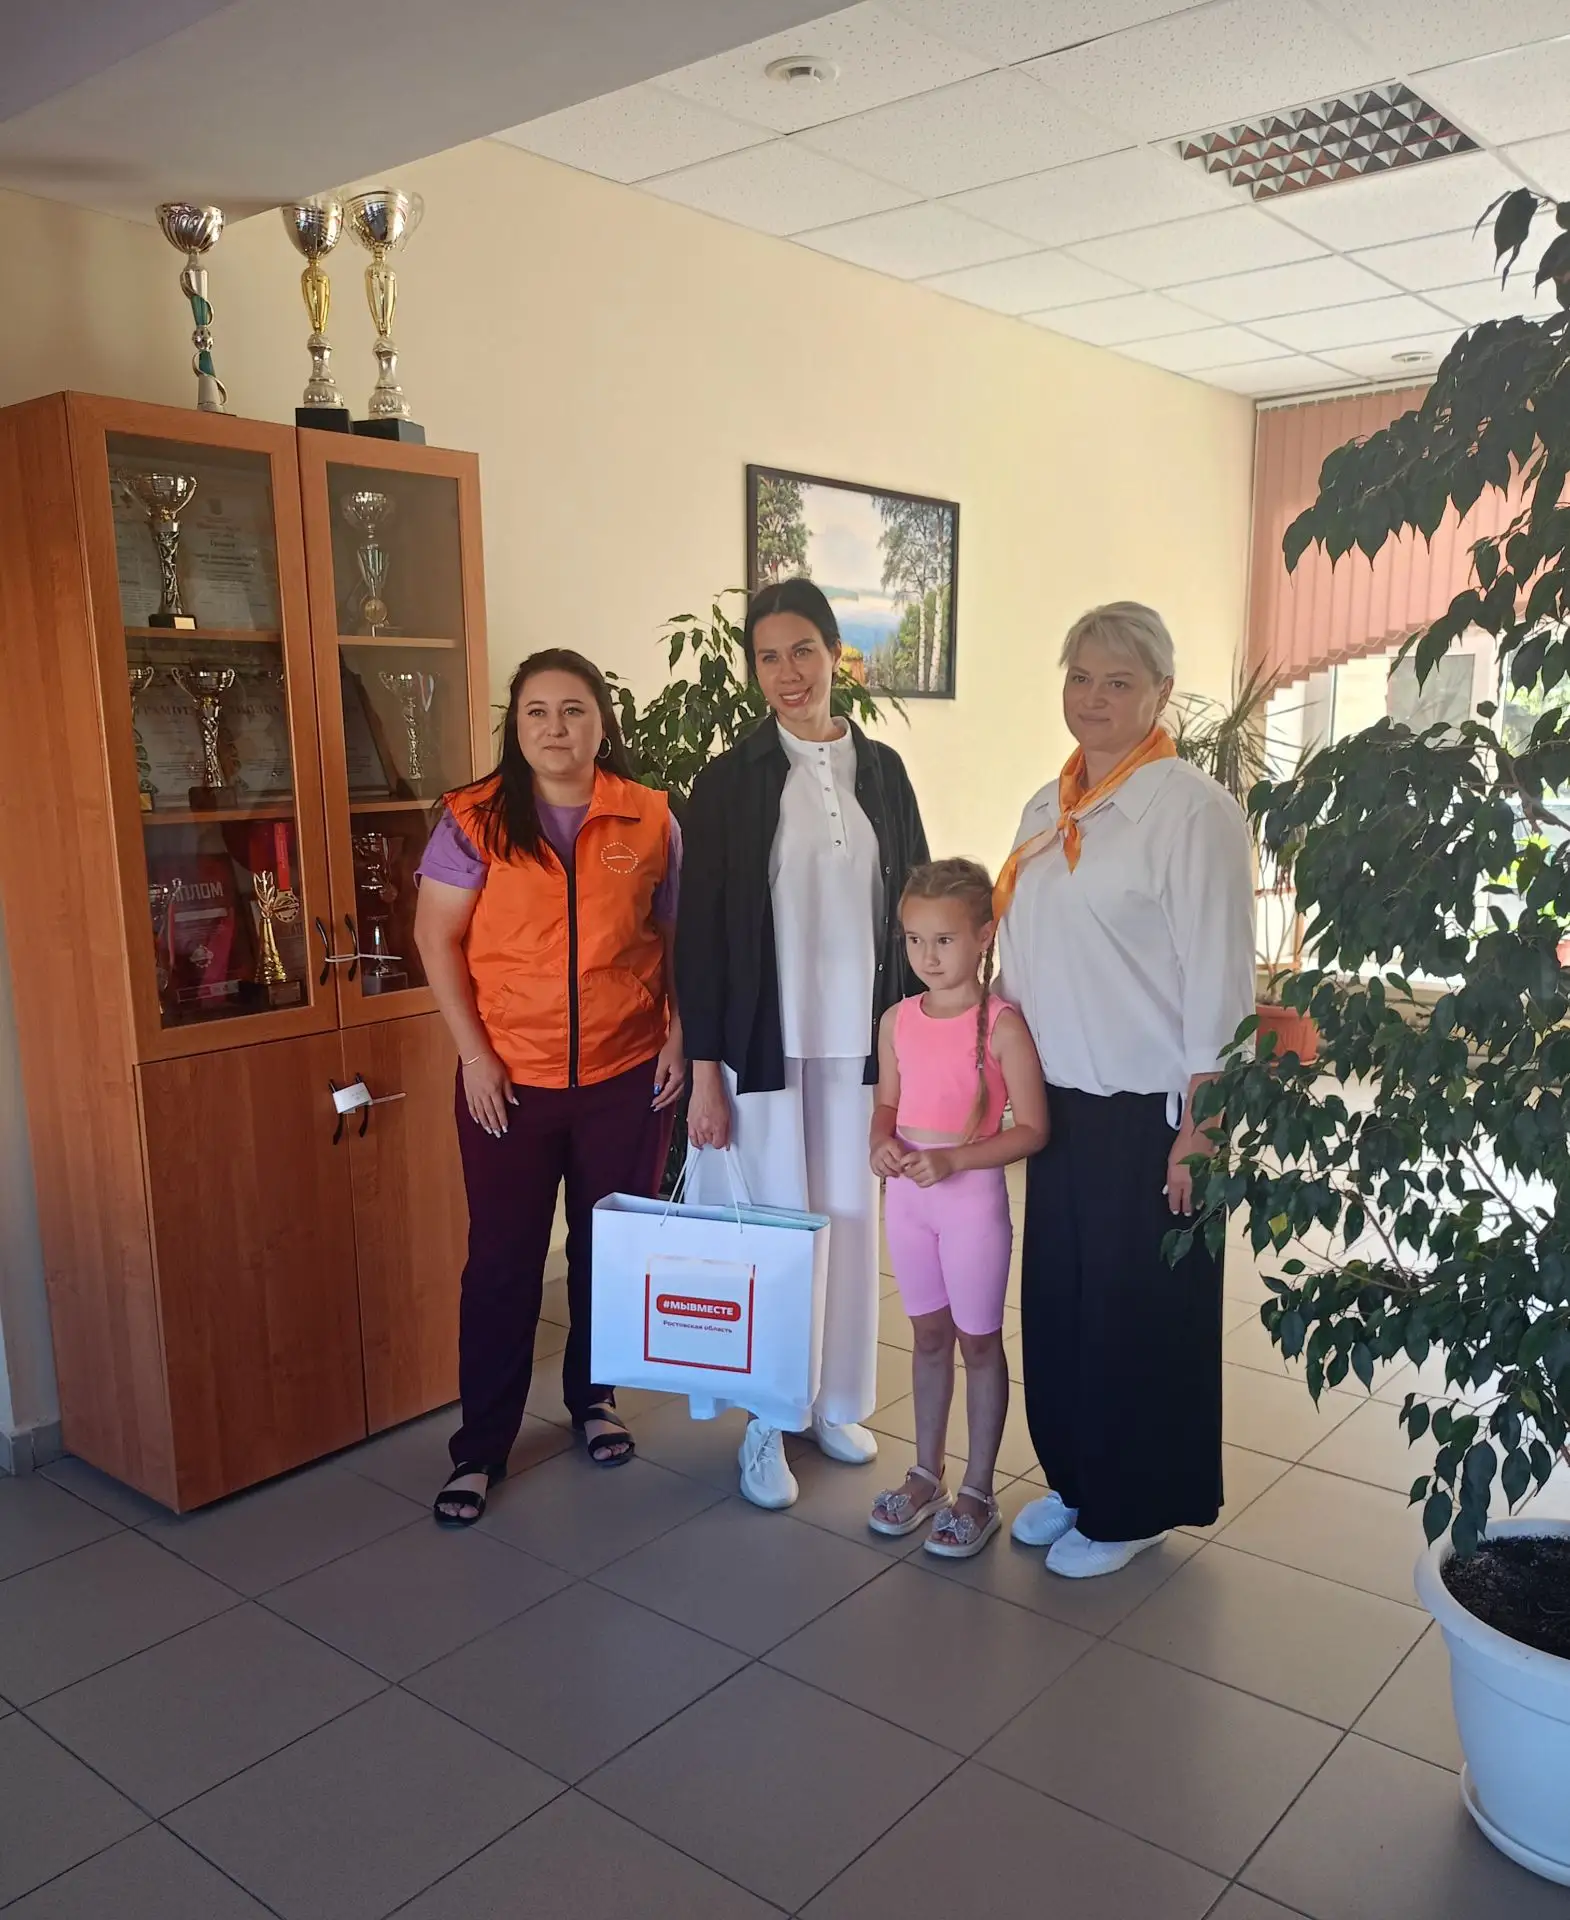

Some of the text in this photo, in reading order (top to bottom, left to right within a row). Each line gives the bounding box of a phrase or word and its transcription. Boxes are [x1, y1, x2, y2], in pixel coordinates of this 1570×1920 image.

[663, 1299, 734, 1315] #МЫВМЕСТЕ
[663, 1320, 733, 1333] Ростовская область
